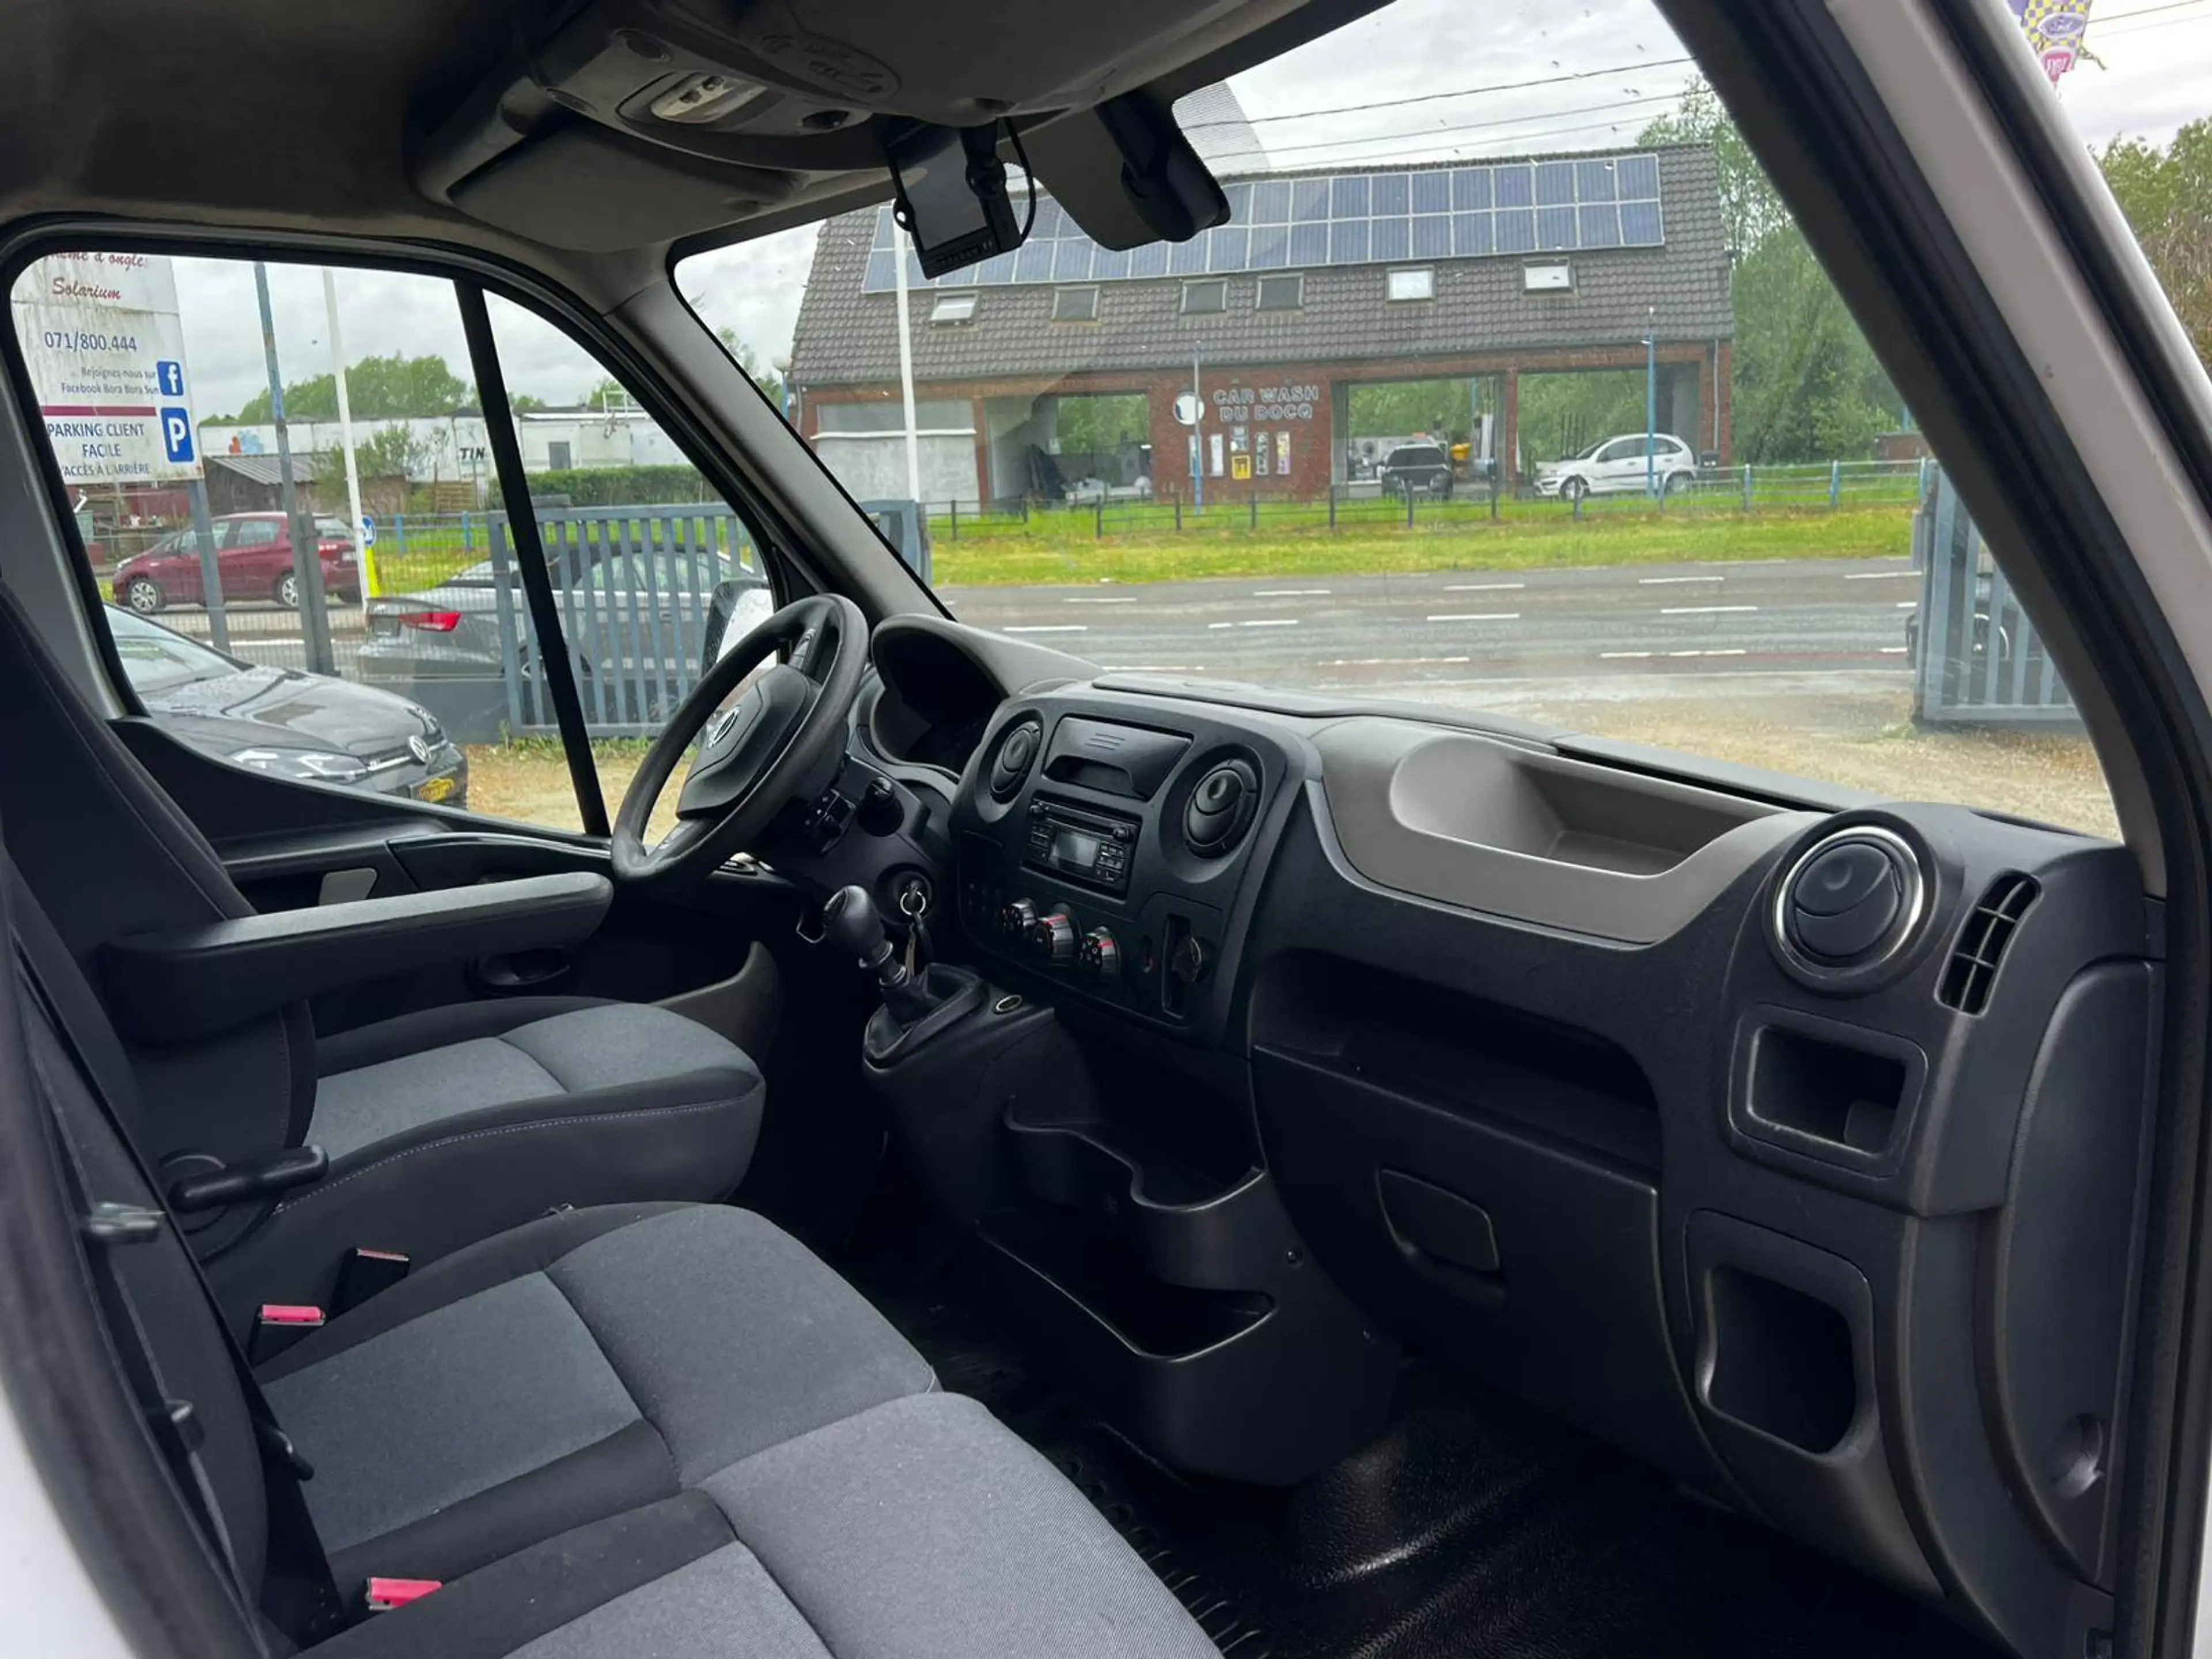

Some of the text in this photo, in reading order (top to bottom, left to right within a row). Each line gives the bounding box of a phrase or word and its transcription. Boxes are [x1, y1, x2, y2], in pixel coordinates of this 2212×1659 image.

[52, 276, 122, 300] Solarium
[44, 331, 137, 353] 071/800.444
[60, 382, 101, 395] Facebook
[1213, 385, 1319, 406] CAR WASH
[1219, 405, 1249, 422] DU
[47, 423, 145, 438] PARKING CLIENT
[82, 443, 122, 457] FACILE
